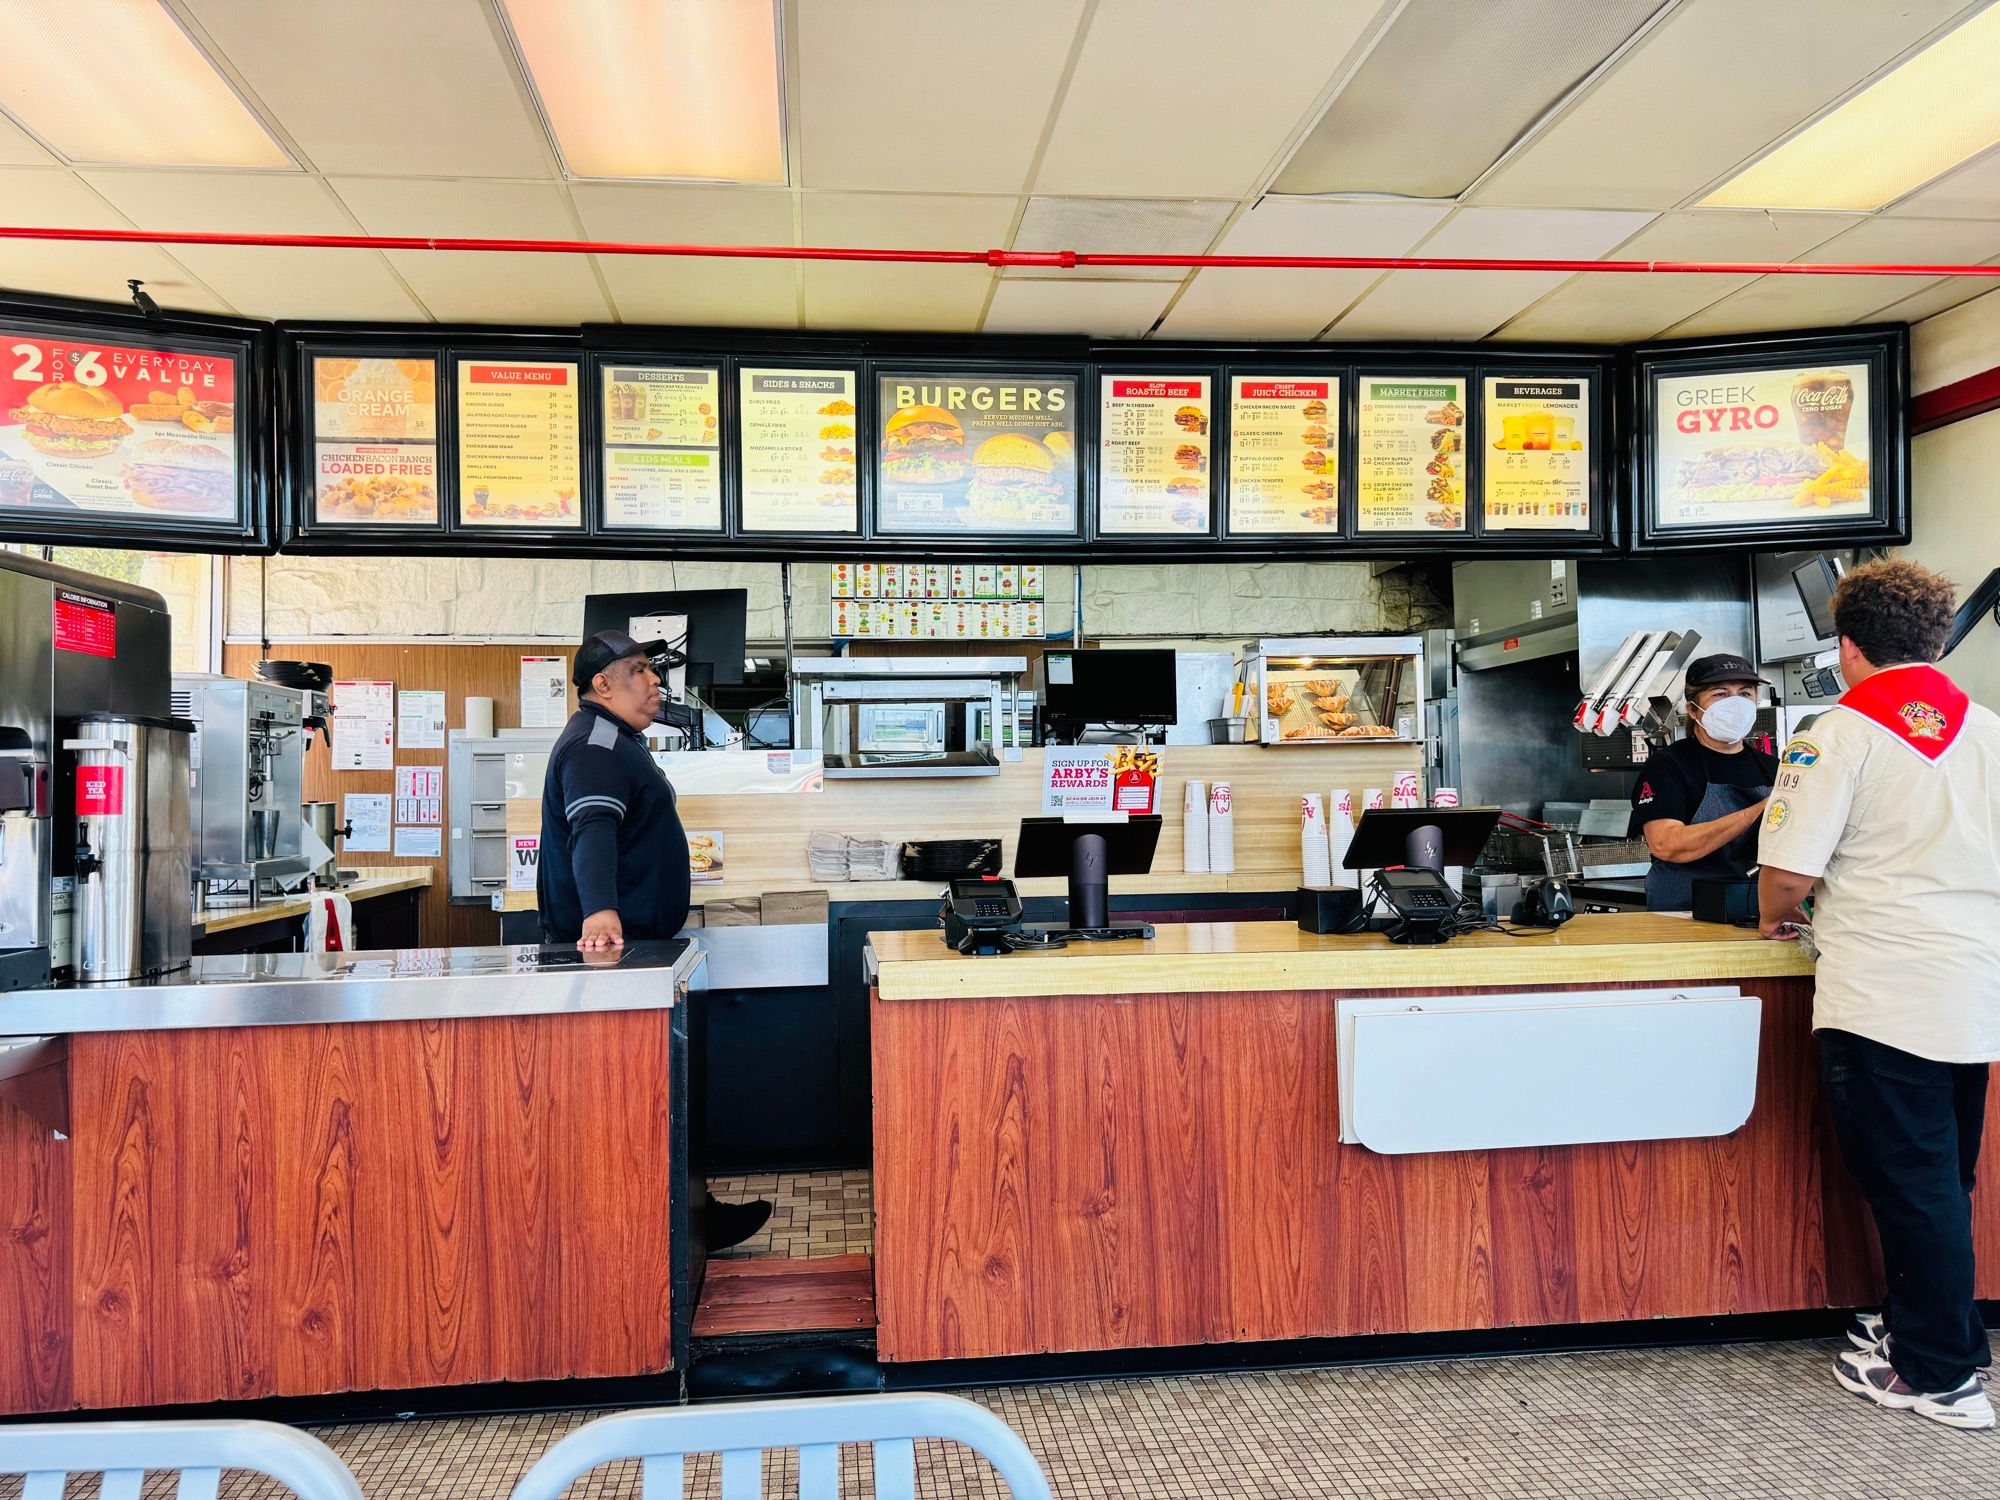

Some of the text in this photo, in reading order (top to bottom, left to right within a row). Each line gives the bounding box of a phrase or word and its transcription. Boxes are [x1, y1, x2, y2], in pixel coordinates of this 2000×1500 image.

[10, 343, 43, 382] 2
[113, 353, 214, 372] EVERYDAY
[113, 366, 215, 387] VALUE
[491, 370, 552, 381] VALUE MENU
[638, 372, 685, 381] DESSERTS
[763, 380, 789, 388] SIDES
[799, 381, 835, 389] SNACKS
[337, 389, 414, 403] ORANGE
[1126, 388, 1189, 396] ROASTED BEEF
[1252, 389, 1317, 397] JUICY CHICKEN
[1380, 388, 1446, 397] MARKET FRESH
[1514, 387, 1563, 395] BEVERAGES
[1677, 385, 1756, 407] GREEK
[1795, 384, 1849, 407] Coca-Cola
[896, 385, 1066, 412] BURGERS
[345, 403, 410, 417] CREAM
[1363, 404, 1373, 412] 10
[1801, 404, 1843, 413] ZERO SUGAR
[1676, 404, 1780, 434] GYRO
[321, 454, 365, 462] CHICKEN
[366, 455, 398, 463] BACON
[633, 455, 692, 465] KIDS MEALS
[1362, 457, 1372, 465] 12
[321, 463, 433, 476] LOADED FRIES
[1362, 507, 1372, 515] 14
[80, 596, 108, 609] INFORMATION
[1051, 767, 1109, 779] ARBY'S
[1051, 780, 1108, 788] REWARDS
[1778, 771, 1800, 789] 109
